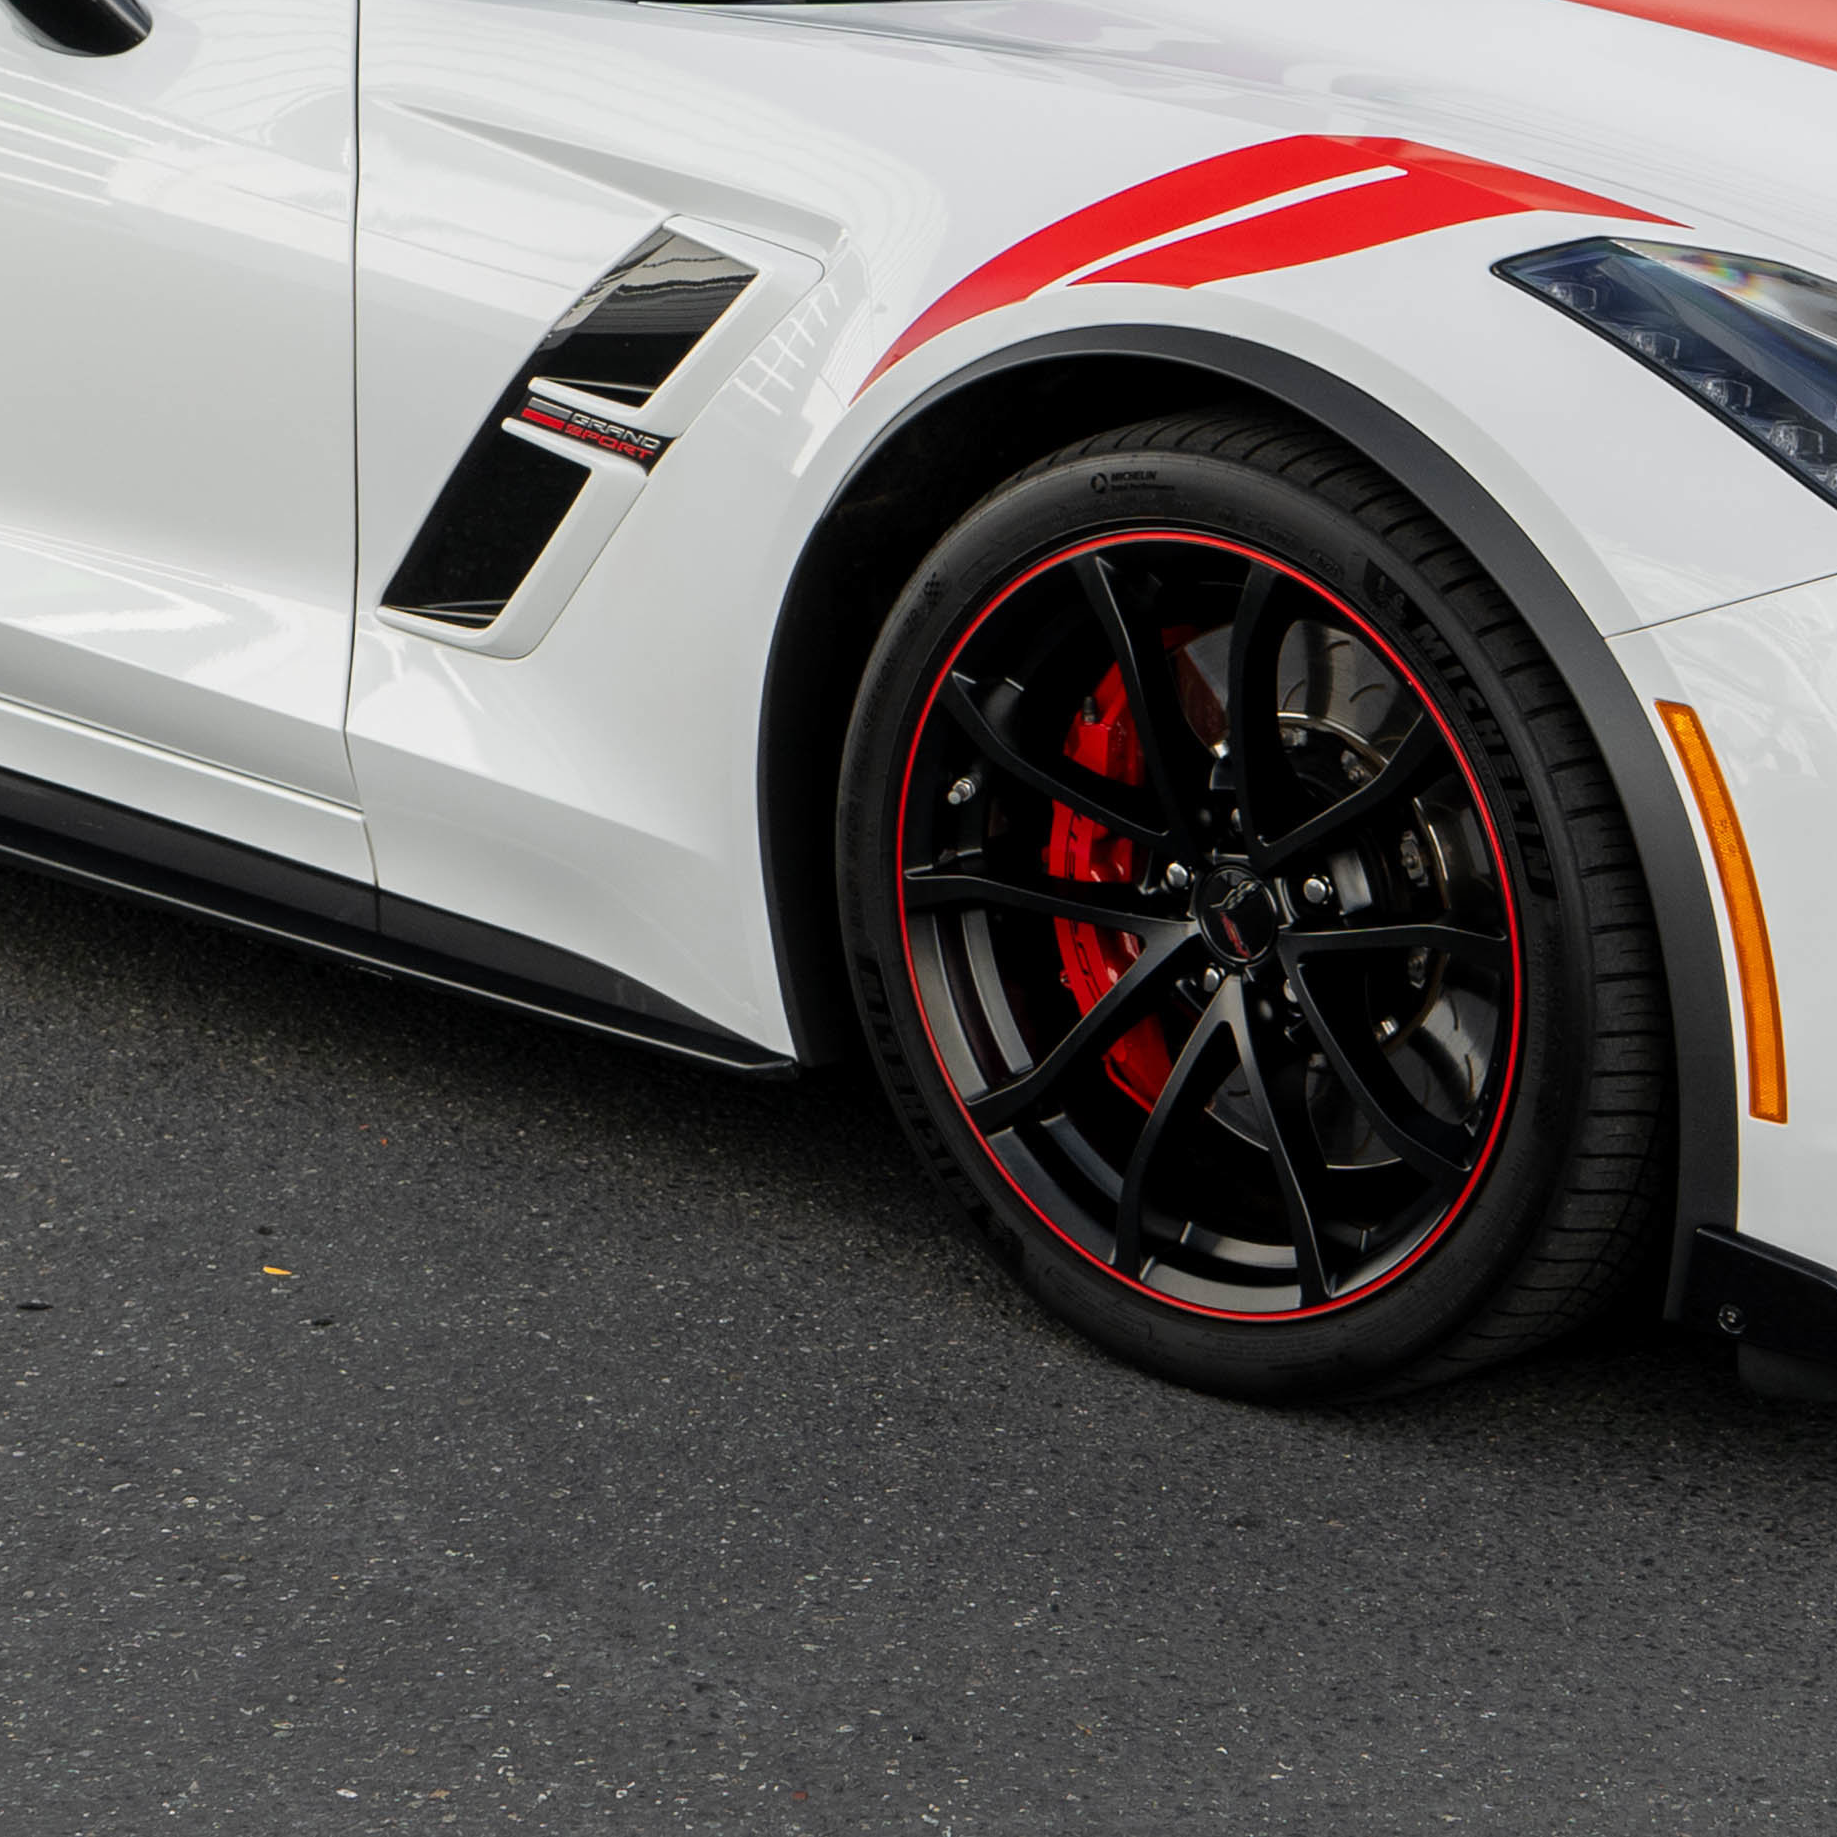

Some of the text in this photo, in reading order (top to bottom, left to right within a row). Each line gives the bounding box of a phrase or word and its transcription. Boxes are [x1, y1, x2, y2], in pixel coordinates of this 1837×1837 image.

[564, 424, 656, 460] SPORT
[570, 412, 662, 451] GRAND
[1111, 470, 1157, 482] MICHELIN
[1412, 619, 1556, 882] MICHELIN
